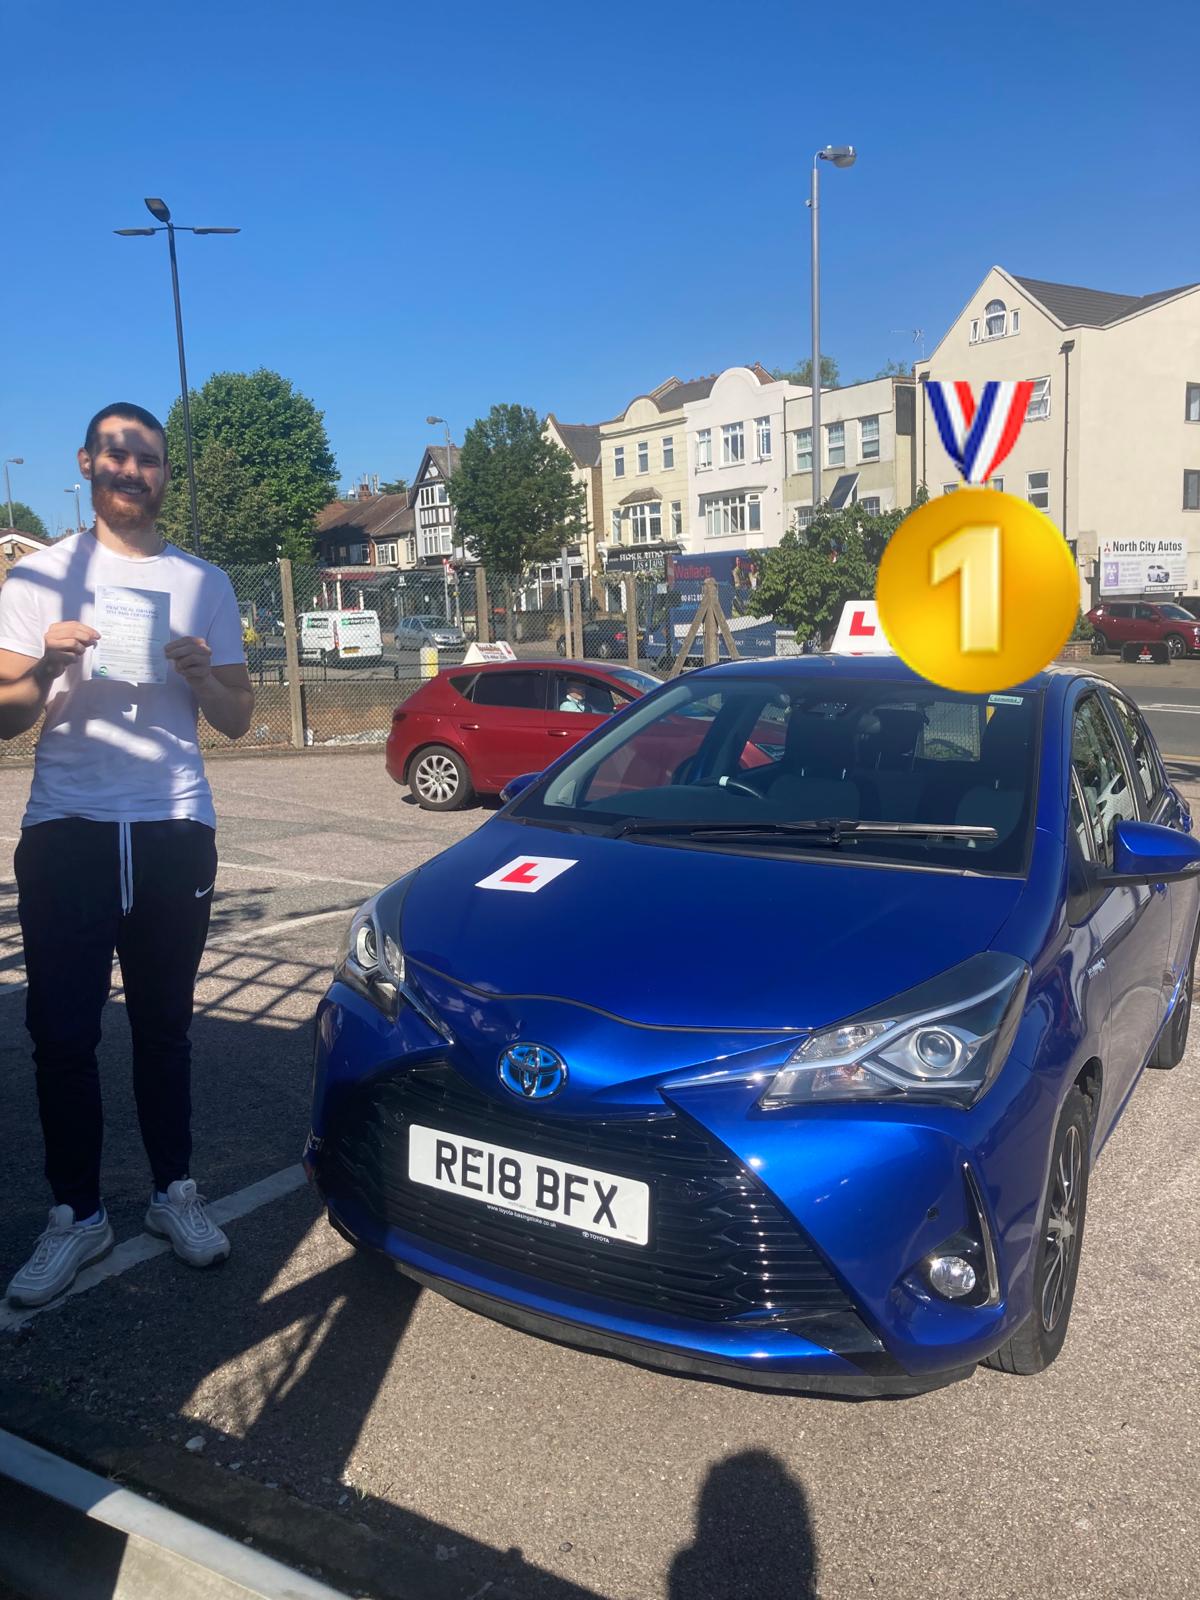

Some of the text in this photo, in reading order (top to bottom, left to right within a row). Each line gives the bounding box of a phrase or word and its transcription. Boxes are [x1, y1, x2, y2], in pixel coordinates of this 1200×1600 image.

[1112, 541, 1183, 553] North City Autos
[675, 565, 711, 579] Wallace
[849, 611, 876, 636] L
[499, 862, 539, 884] L
[435, 1139, 618, 1230] RE18 BFX
[590, 1233, 610, 1244] TOYOTA
